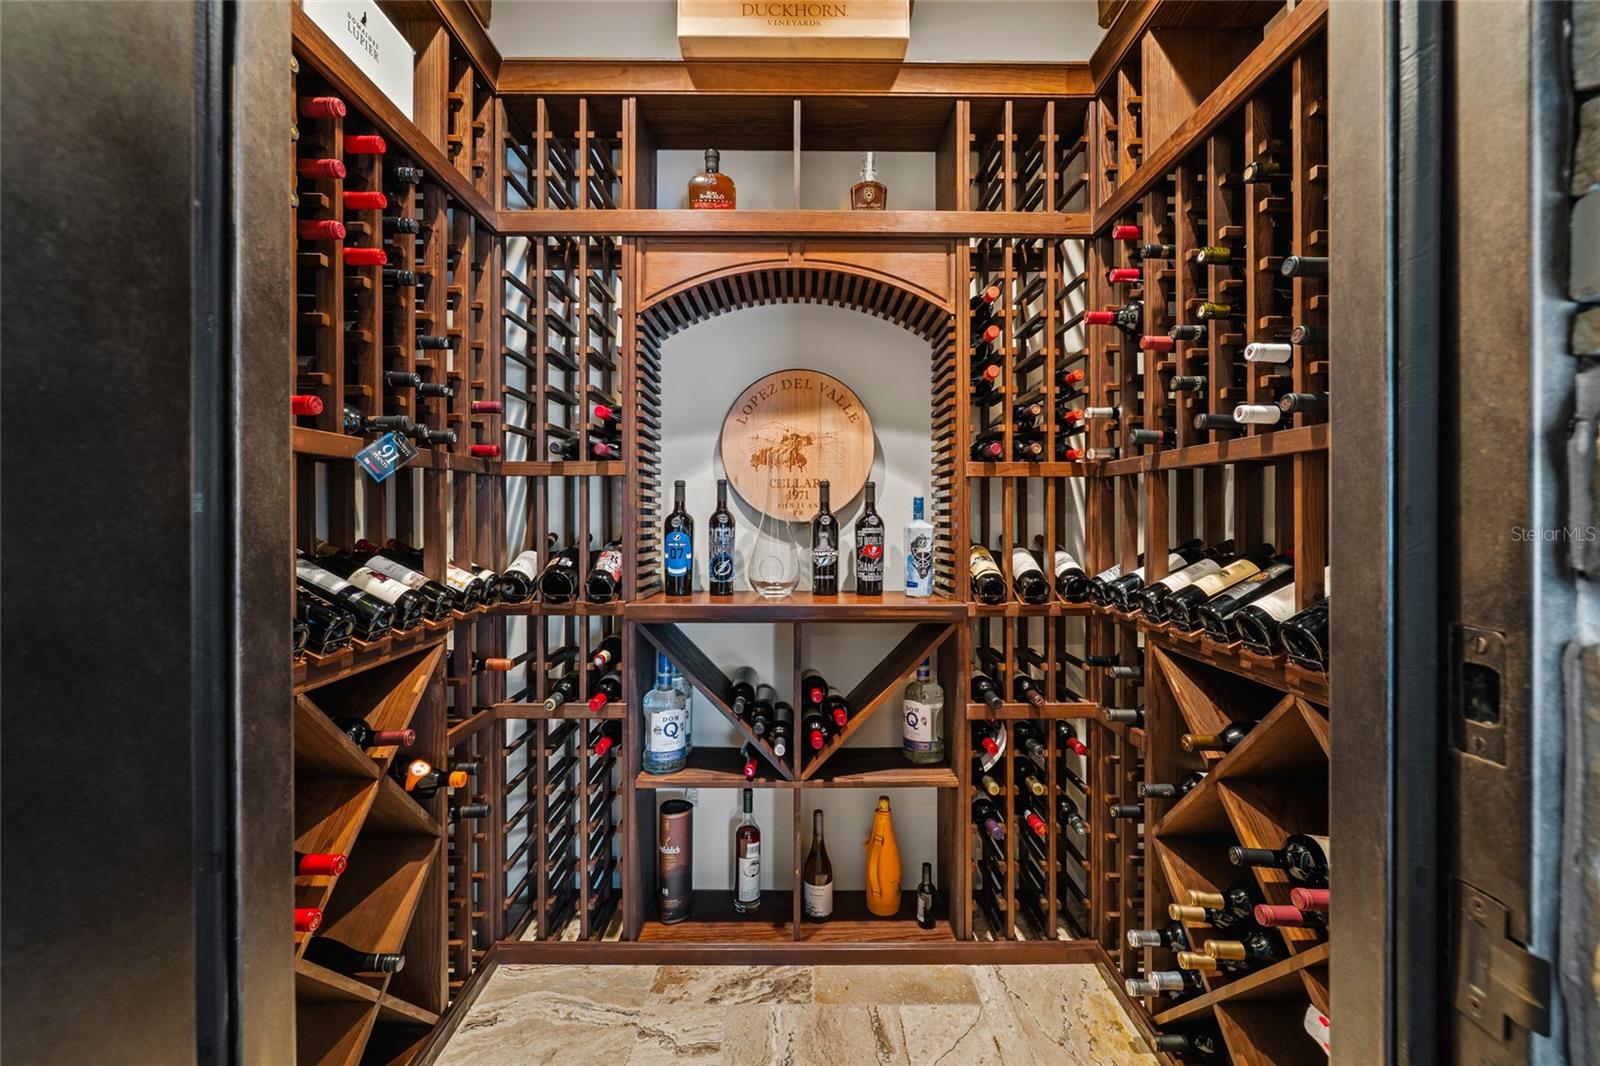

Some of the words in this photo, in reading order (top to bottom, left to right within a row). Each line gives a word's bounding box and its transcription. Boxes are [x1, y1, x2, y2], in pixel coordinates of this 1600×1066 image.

[742, 3, 847, 17] DUCKHORN
[347, 11, 379, 50] DOMAINES
[767, 19, 821, 27] VINEYARDS
[347, 20, 380, 63] LUPIER
[736, 383, 778, 425] LOPEZ
[781, 378, 813, 391] DEL
[819, 382, 860, 424] VALLE
[377, 444, 400, 465] 91
[788, 490, 809, 500] 1971
[670, 547, 684, 559] 07
[662, 714, 679, 722] DON
[906, 712, 919, 730] Q
[664, 722, 679, 739] Q
